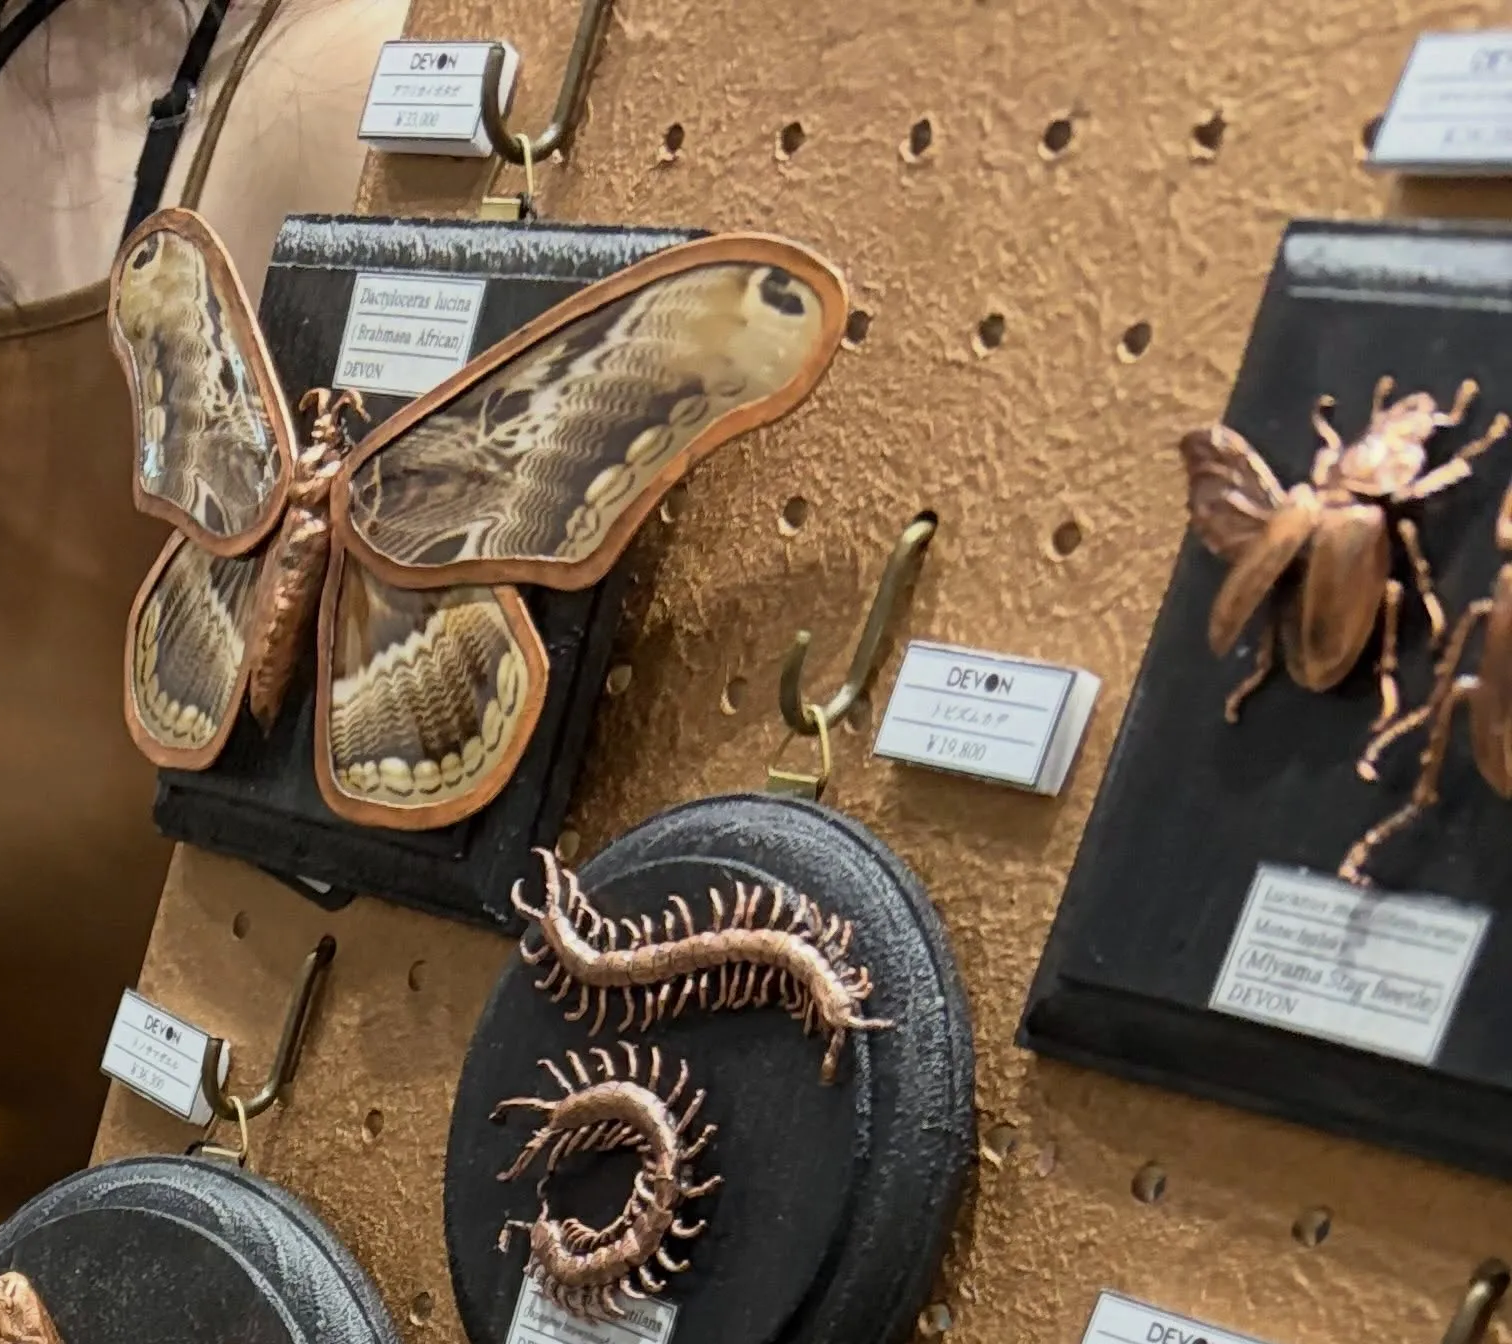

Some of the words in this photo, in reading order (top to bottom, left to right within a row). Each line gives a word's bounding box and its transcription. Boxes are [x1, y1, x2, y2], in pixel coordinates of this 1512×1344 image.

[408, 52, 459, 70] DEVON
[414, 327, 466, 354] African)
[342, 358, 384, 381] DEVON
[944, 665, 1016, 697] DEVON
[1227, 981, 1300, 1016] DEVON
[143, 1012, 183, 1048] DEVON
